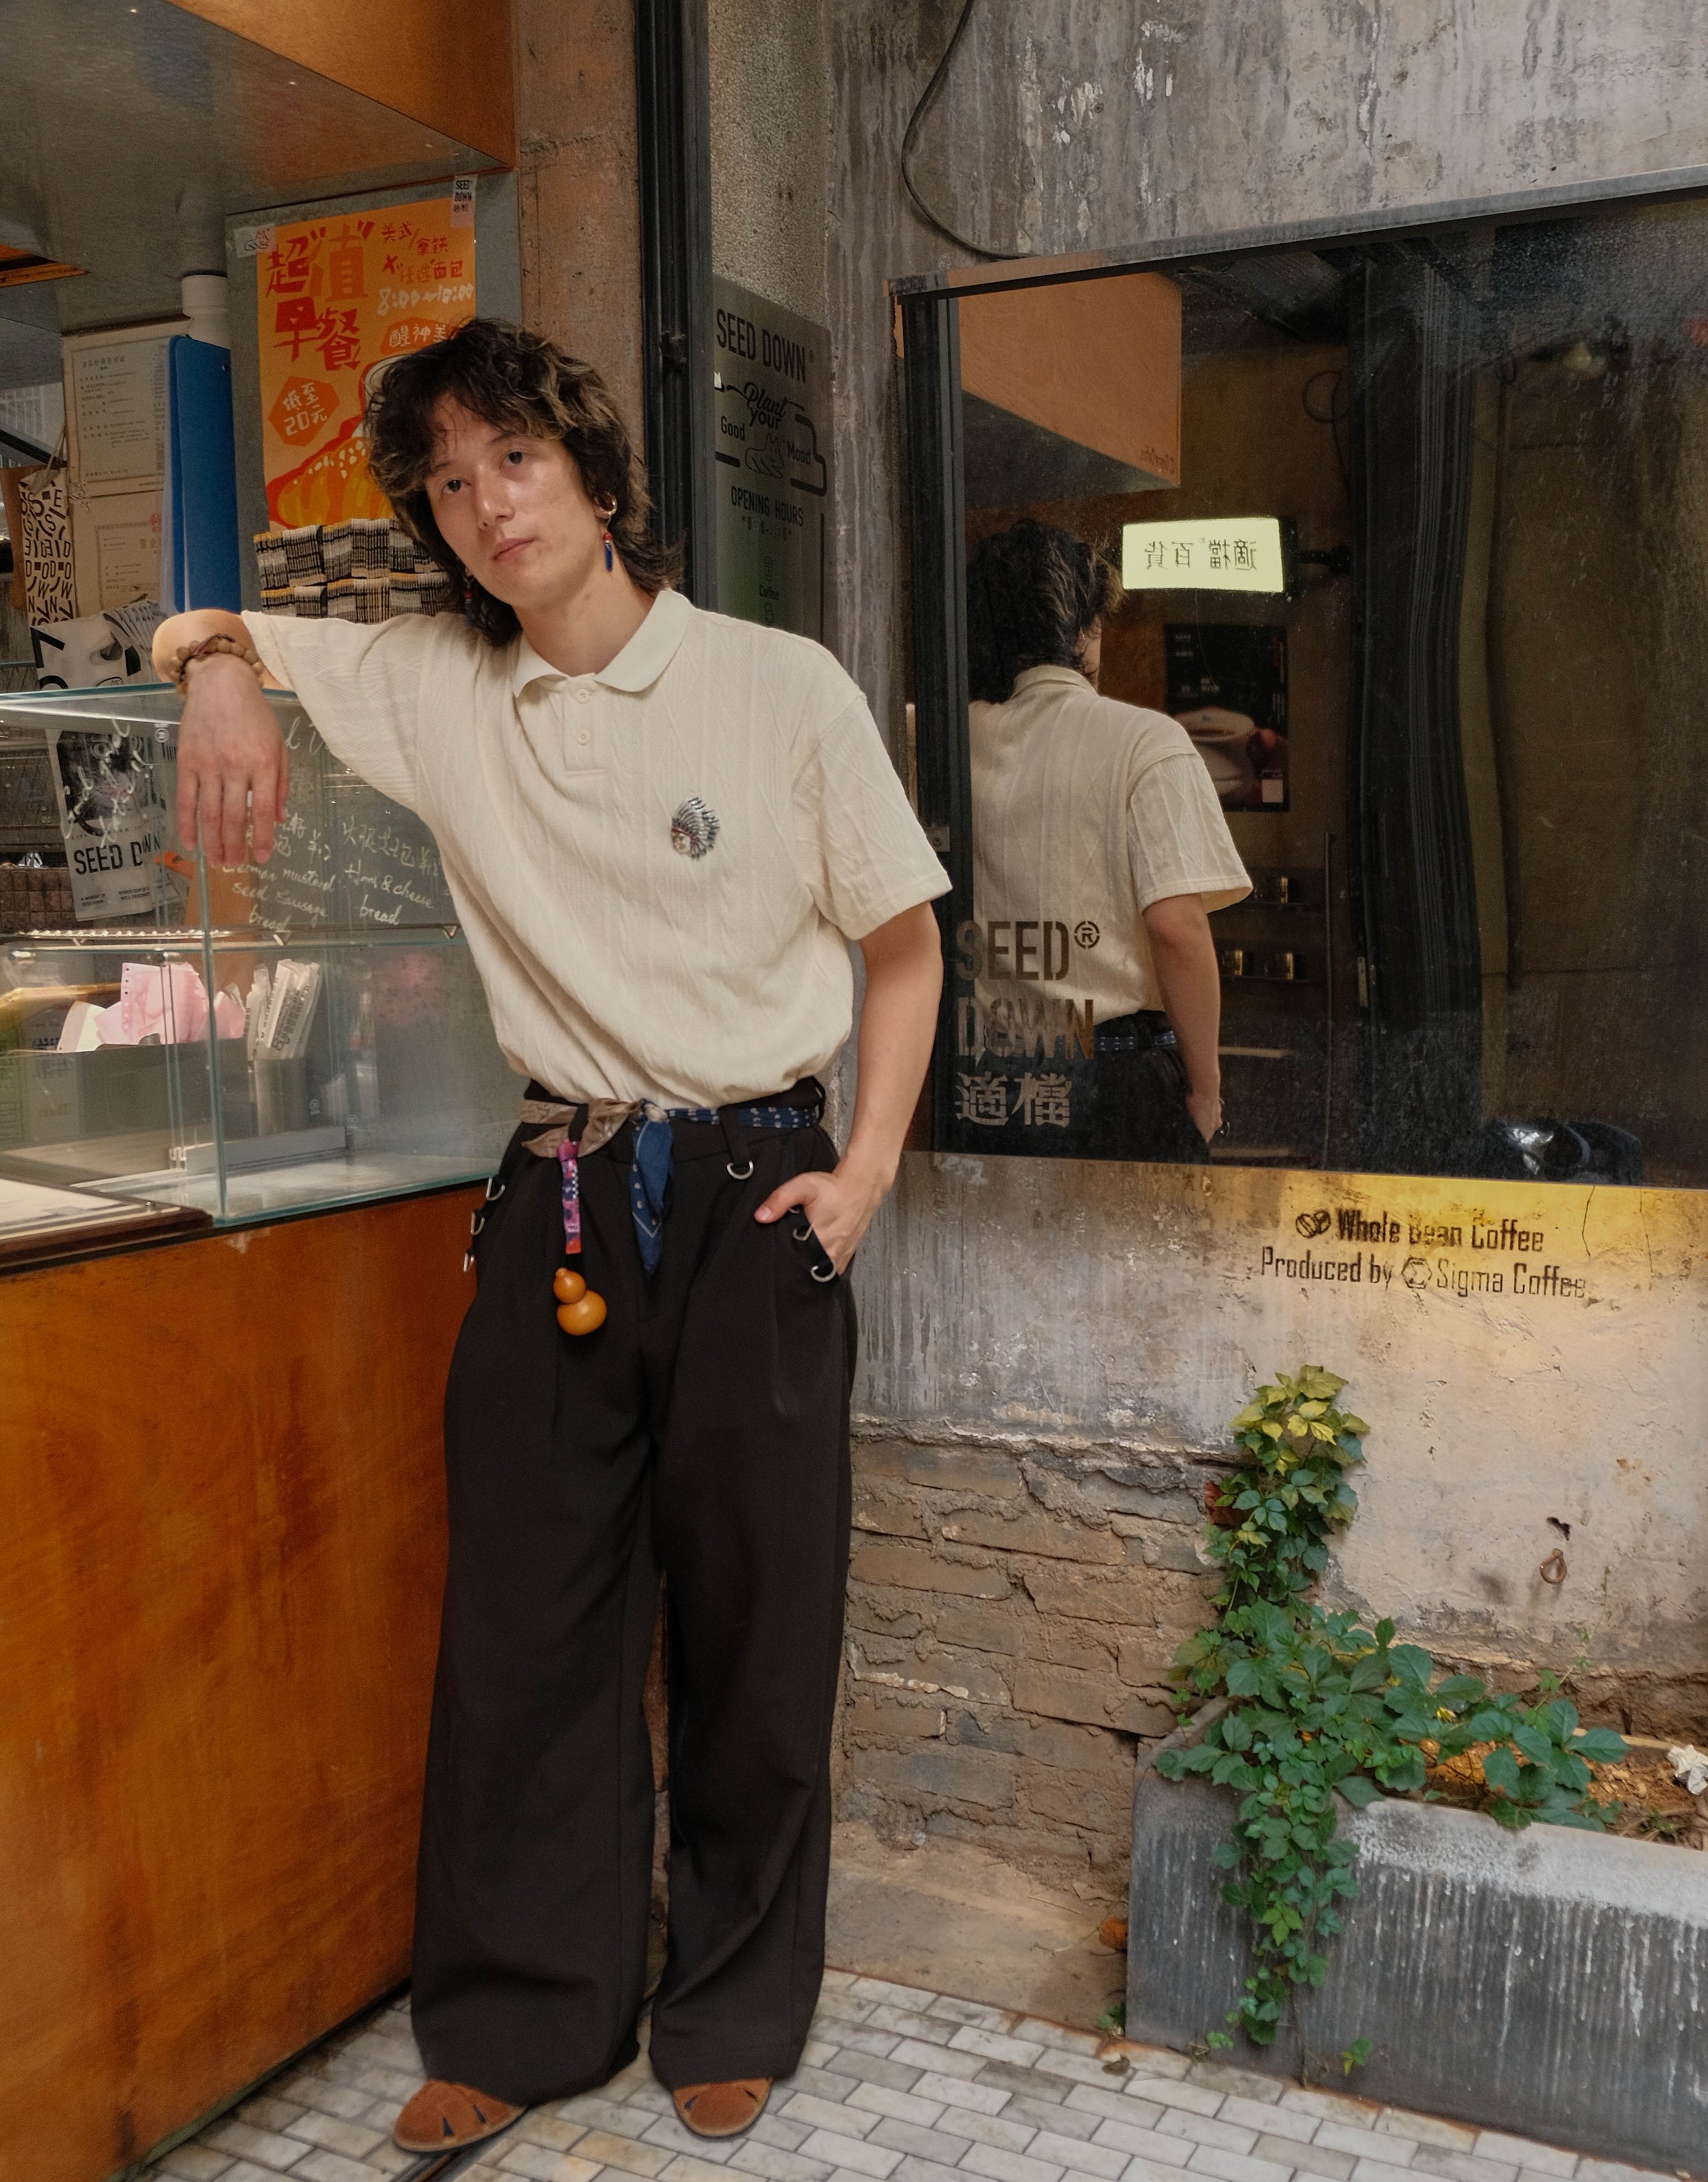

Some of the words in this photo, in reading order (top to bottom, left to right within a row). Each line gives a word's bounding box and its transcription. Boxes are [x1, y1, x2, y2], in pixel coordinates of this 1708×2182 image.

[273, 293, 361, 372] 早餐
[717, 308, 756, 361] SEED
[762, 328, 806, 383] DOWN
[284, 404, 327, 437] 20元
[721, 415, 745, 441] Good
[730, 485, 770, 516] OPENING
[775, 499, 803, 527] HOURS
[73, 844, 123, 875] SEED
[249, 904, 292, 930] bread
[359, 894, 402, 926] bread
[957, 997, 1094, 1060] DOWN
[1336, 1208, 1401, 1244] Whole
[1471, 1213, 1544, 1252] Coffee
[1261, 1245, 1362, 1283] Produced
[1369, 1253, 1392, 1290] by
[1437, 1258, 1503, 1297] Sigma
[1513, 1262, 1586, 1298] Coffee
